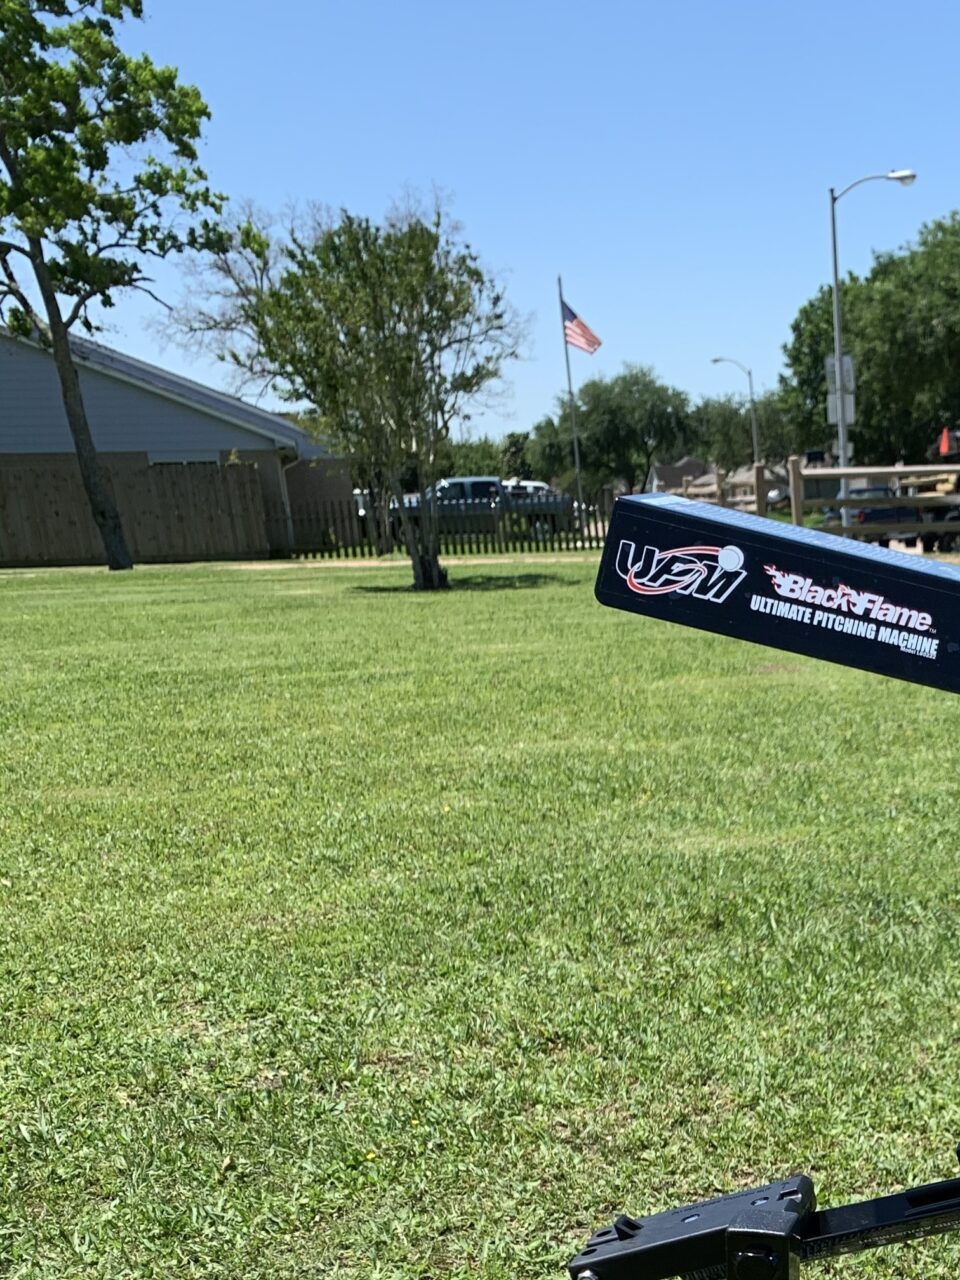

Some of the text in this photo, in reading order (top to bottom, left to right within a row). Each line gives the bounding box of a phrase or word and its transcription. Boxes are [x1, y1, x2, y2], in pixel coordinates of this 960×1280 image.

[615, 539, 747, 604] UPM
[750, 594, 940, 655] ULTIMATE PITCHING MACHINE
